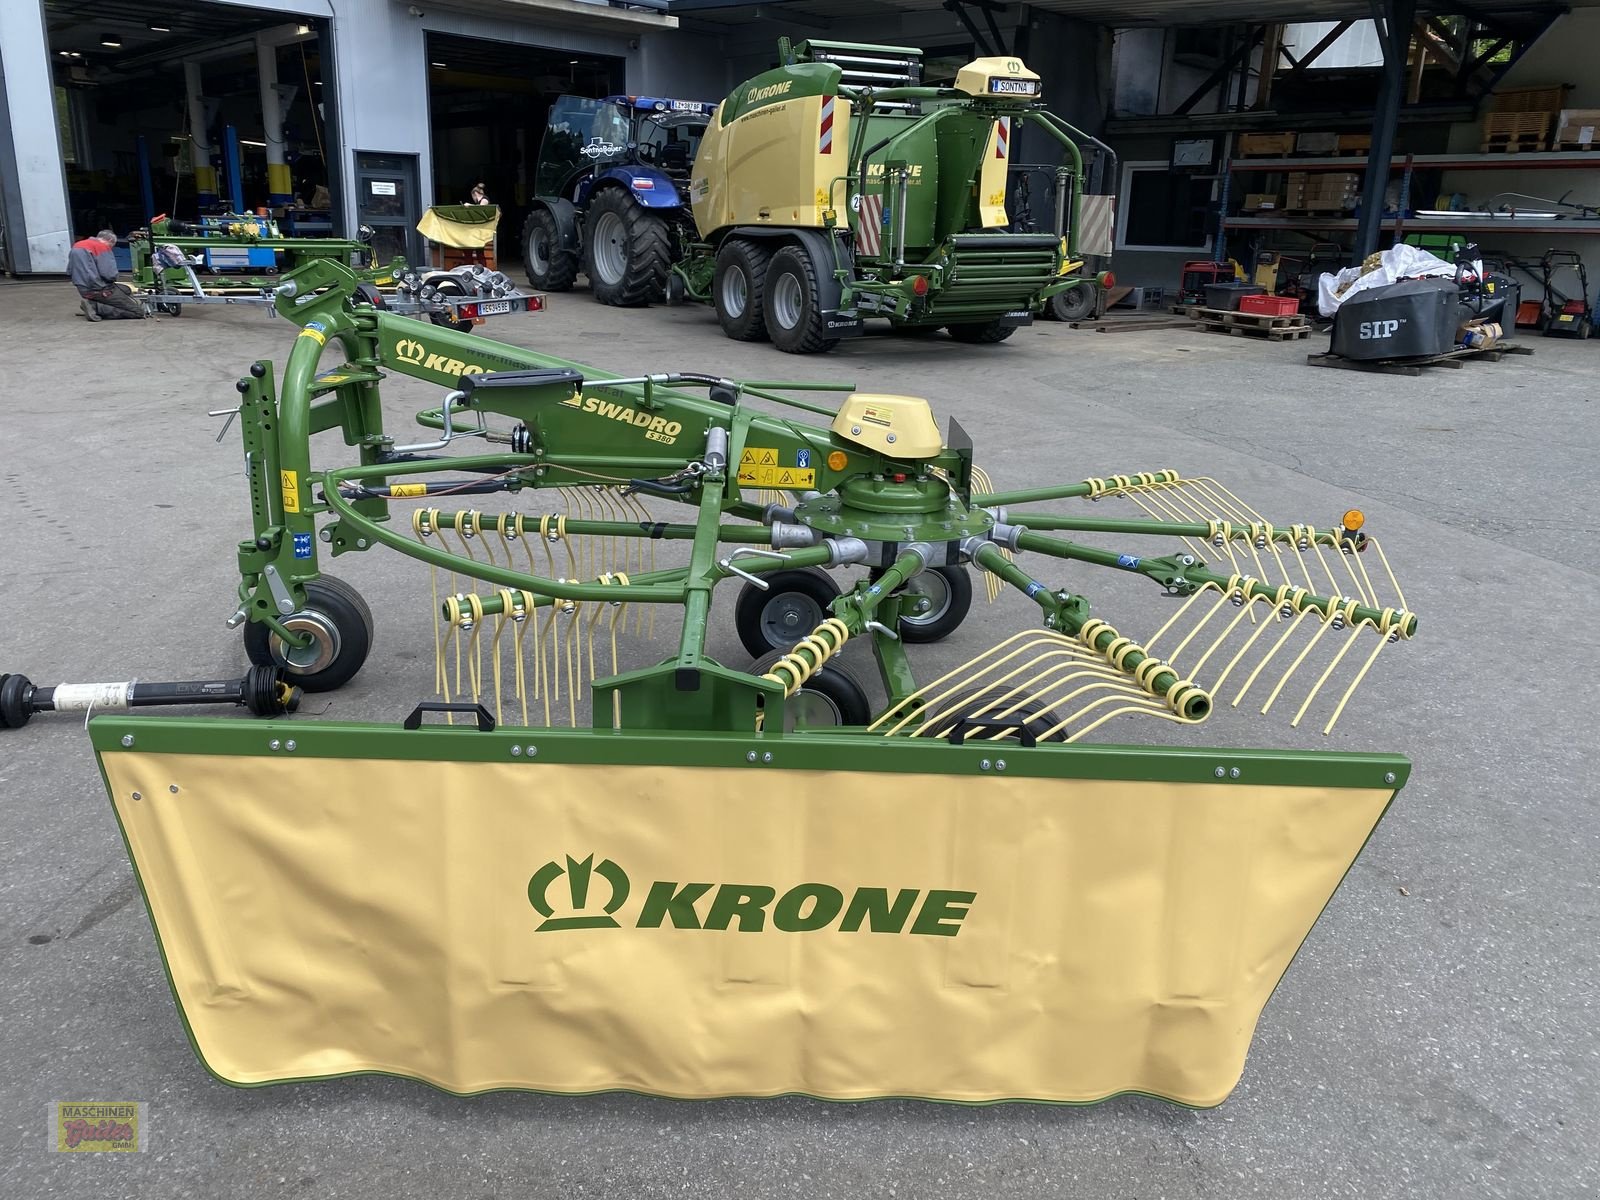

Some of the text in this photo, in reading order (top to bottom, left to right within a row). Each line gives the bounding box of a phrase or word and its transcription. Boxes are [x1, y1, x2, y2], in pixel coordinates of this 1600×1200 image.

[755, 80, 792, 101] KRONE
[1001, 82, 1027, 92] SONTNA
[1360, 320, 1399, 339] SIP
[424, 353, 497, 376] KRO
[582, 397, 682, 436] SWADRO
[655, 434, 671, 444] 380
[635, 881, 977, 937] KRONE
